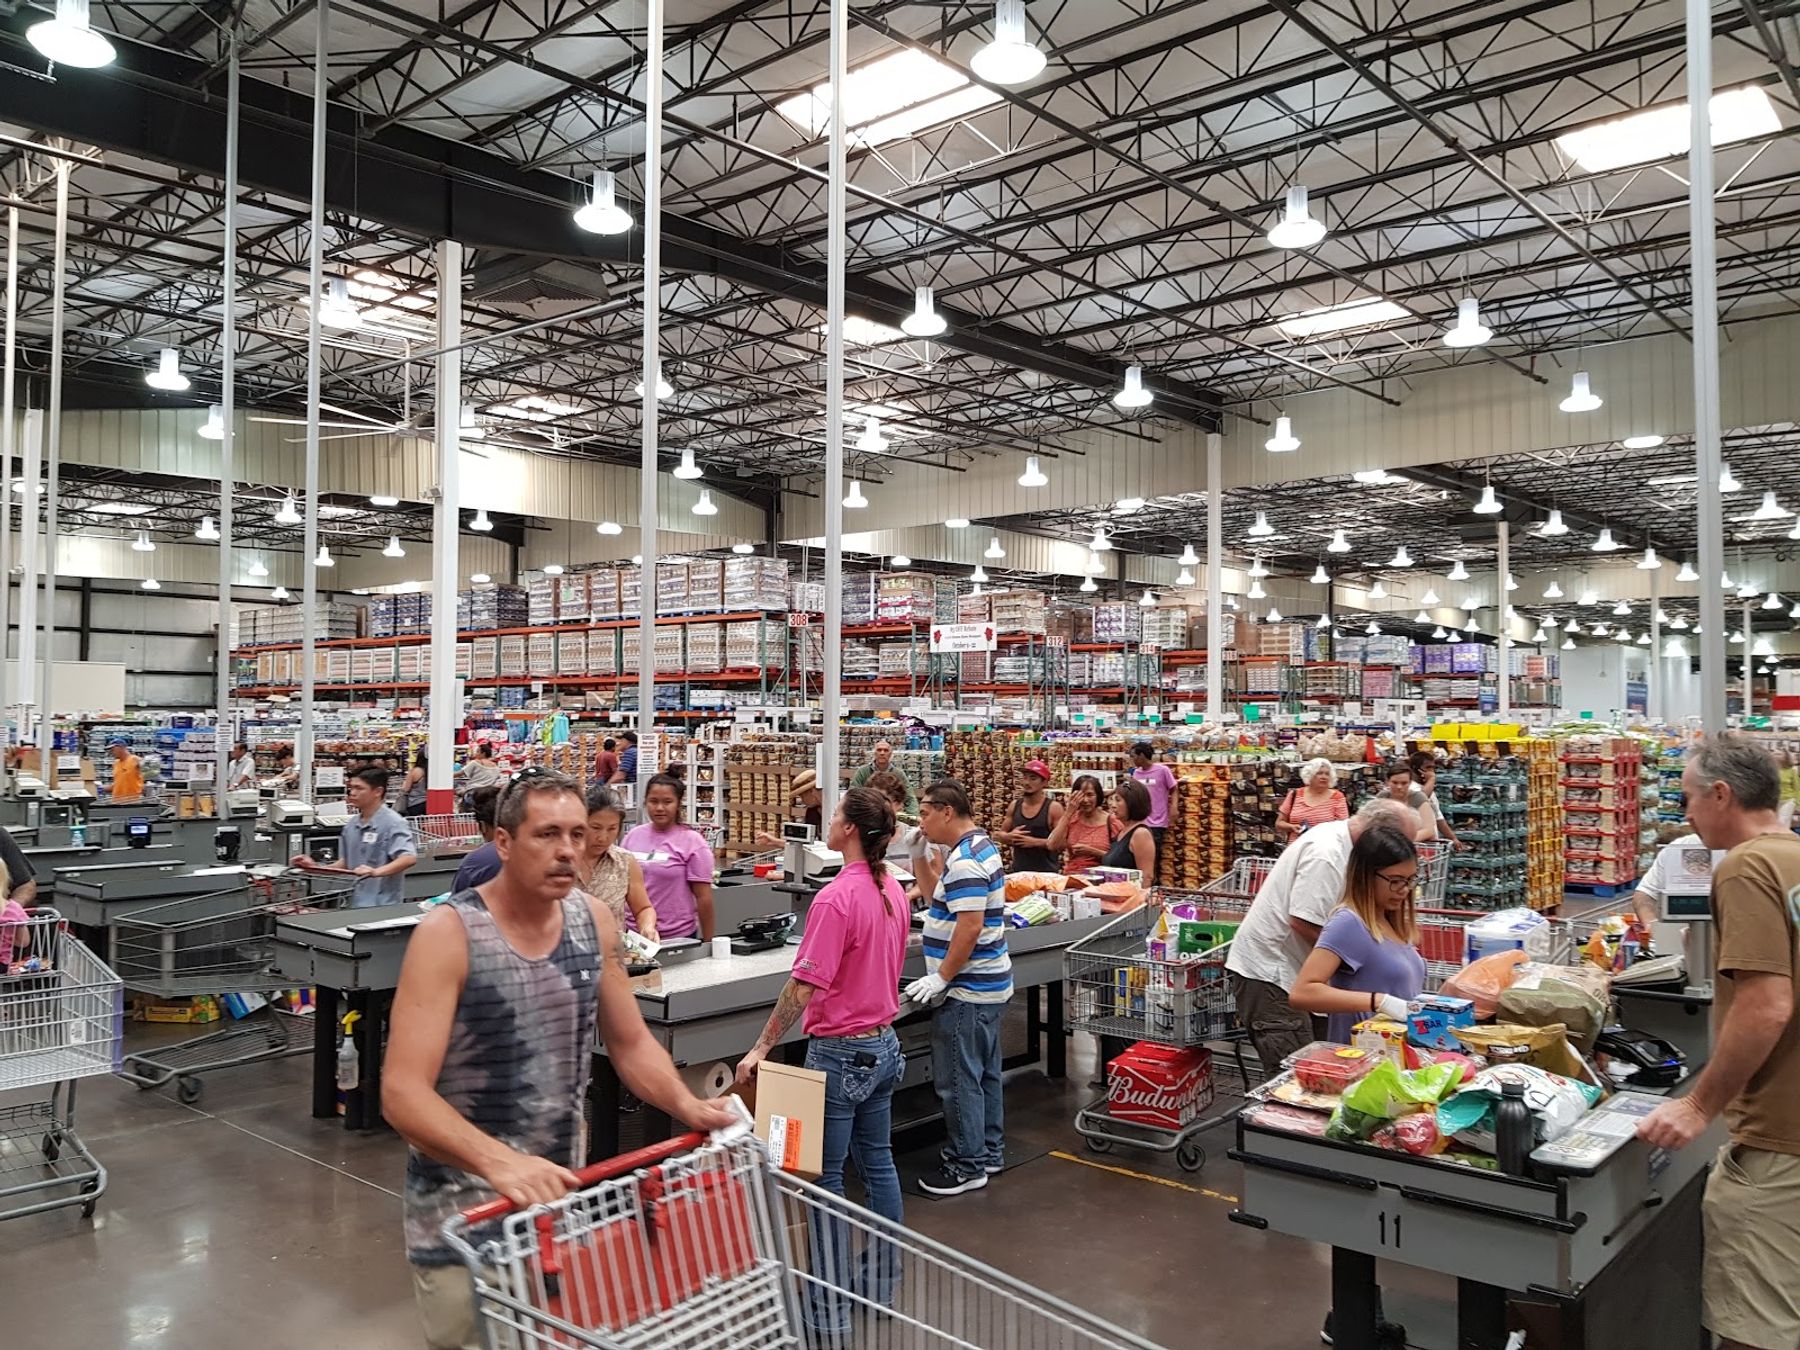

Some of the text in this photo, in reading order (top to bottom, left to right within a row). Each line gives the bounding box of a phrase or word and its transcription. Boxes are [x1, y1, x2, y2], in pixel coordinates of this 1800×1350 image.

[790, 614, 807, 626] 308
[1048, 636, 1062, 646] 312
[1141, 644, 1154, 653] 314
[1379, 1211, 1401, 1249] 11
